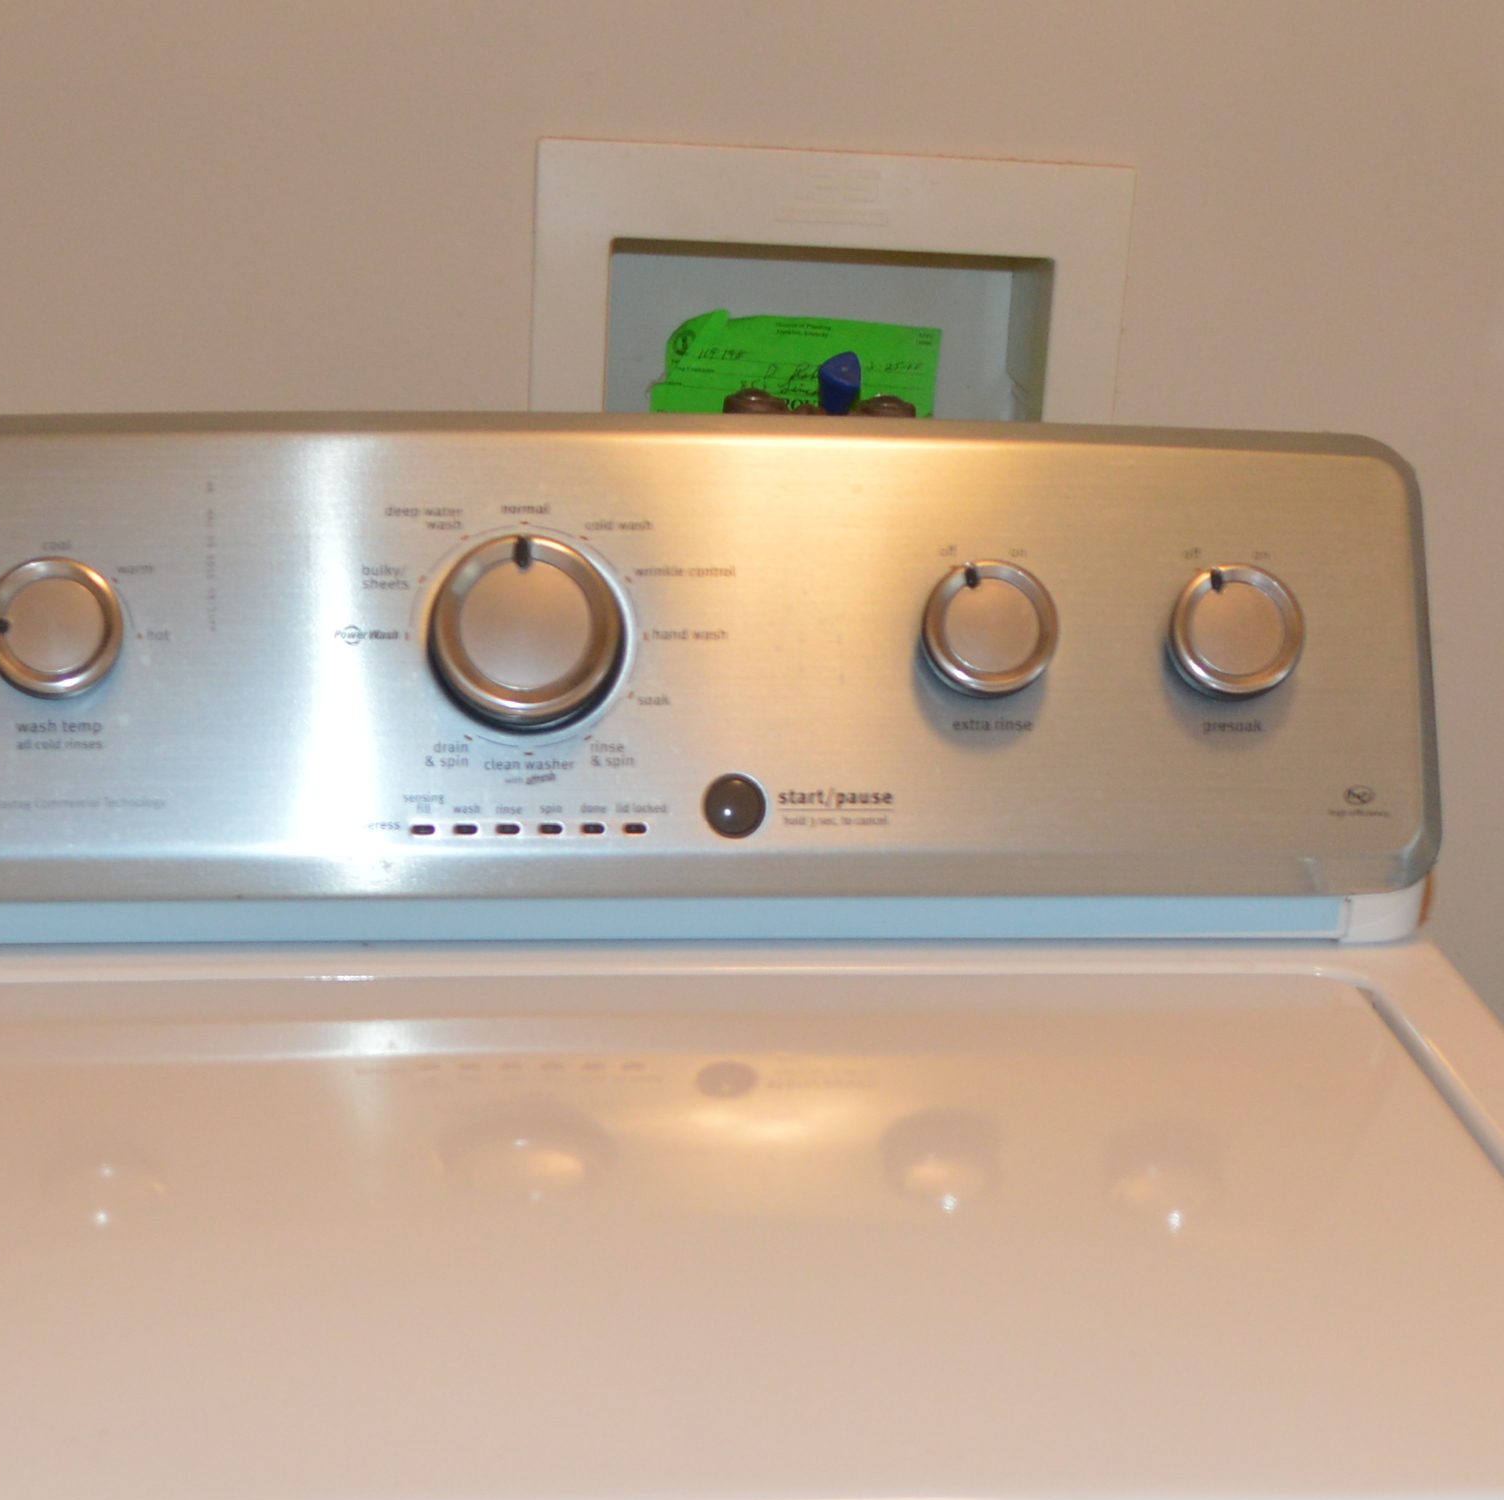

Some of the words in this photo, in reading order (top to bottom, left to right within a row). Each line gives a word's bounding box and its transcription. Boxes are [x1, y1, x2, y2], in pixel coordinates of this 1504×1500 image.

[384, 505, 418, 519] deep
[424, 506, 463, 517] water
[500, 504, 550, 515] normal
[426, 519, 463, 531] wash
[617, 520, 654, 531] wash
[116, 563, 154, 575] warm
[633, 565, 684, 577] wrinkle
[688, 565, 736, 578] control
[362, 578, 410, 591] sheets
[146, 627, 171, 641] hot
[652, 628, 688, 641] hand
[692, 629, 729, 641] wash
[636, 693, 671, 706] soak
[15, 718, 57, 733] wash
[62, 718, 104, 735] temp
[952, 718, 991, 732] extra
[994, 717, 1034, 732] rinse
[1203, 719, 1263, 736] presoak
[65, 738, 104, 750] rinses
[433, 741, 469, 754] drain
[590, 741, 625, 752] rinse
[425, 756, 436, 767] &
[442, 755, 470, 770] spin
[484, 758, 521, 771] clean
[525, 759, 575, 770] washer
[590, 755, 602, 767] &
[605, 755, 635, 770] spin
[403, 791, 446, 805] sensing
[777, 787, 894, 810] start/pause
[416, 804, 432, 814] fill
[452, 804, 481, 814] wash
[496, 804, 523, 814] rinse
[539, 804, 563, 818] spin
[579, 803, 608, 814] done
